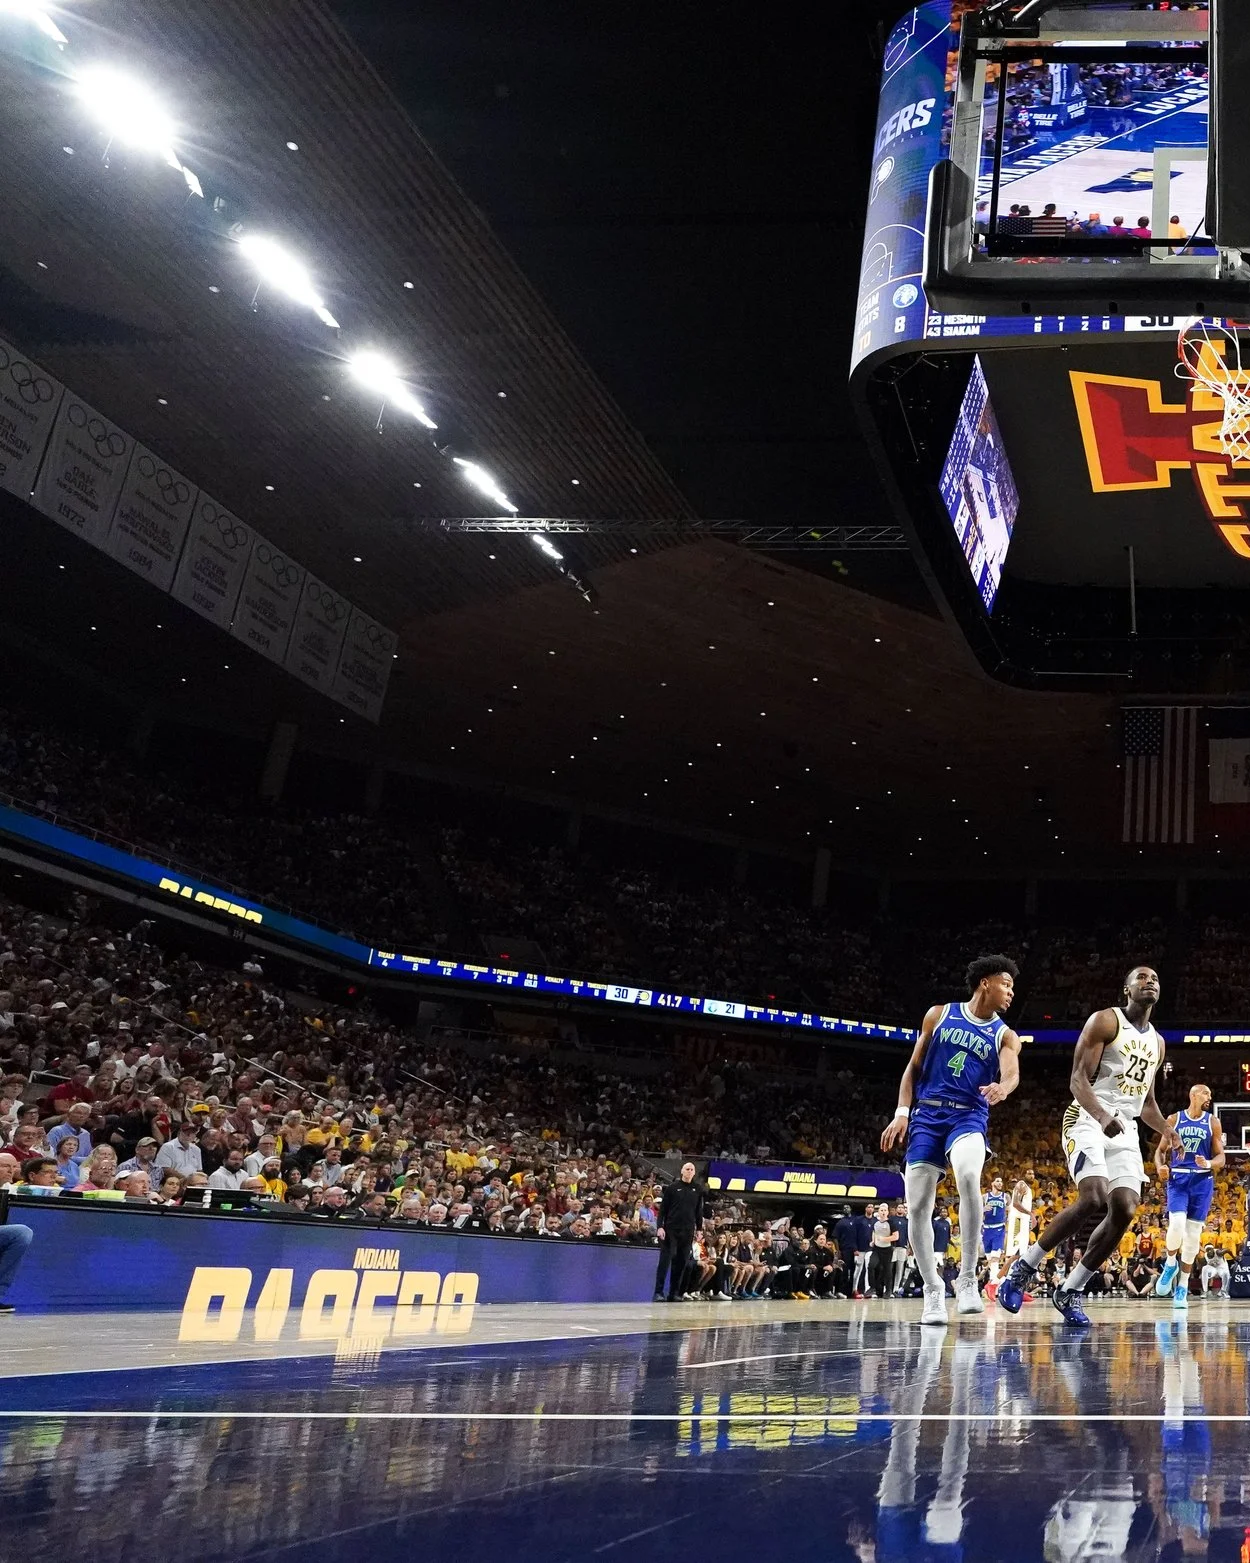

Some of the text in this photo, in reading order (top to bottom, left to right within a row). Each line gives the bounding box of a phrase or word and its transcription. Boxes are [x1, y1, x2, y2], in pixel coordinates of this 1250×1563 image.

[876, 98, 937, 157] CERS
[894, 316, 906, 333] 8
[927, 327, 941, 336] 43
[943, 326, 980, 337] SIAKAM
[1059, 322, 1064, 331] 1
[1081, 321, 1089, 330] 2
[1102, 320, 1110, 330] 0
[928, 316, 941, 326] 23
[58, 502, 86, 528] 1972
[382, 959, 388, 967] 4
[412, 963, 419, 971] 5
[443, 968, 452, 976] 12
[473, 972, 479, 980] 7
[614, 988, 628, 999] 30
[658, 994, 682, 1008] 41.7
[725, 1004, 735, 1014] 21
[940, 1026, 992, 1061] WOLVES
[1119, 1040, 1156, 1068] INDIANA
[947, 1051, 968, 1077] 4
[1125, 1053, 1149, 1083] 23
[1114, 1073, 1148, 1096] PACERS
[1178, 1126, 1207, 1140] WOLVES
[1184, 1137, 1202, 1153] 27
[783, 1171, 816, 1183] INDIANA
[353, 1247, 400, 1269] INDIANA
[1235, 1274, 1247, 1283] St.
